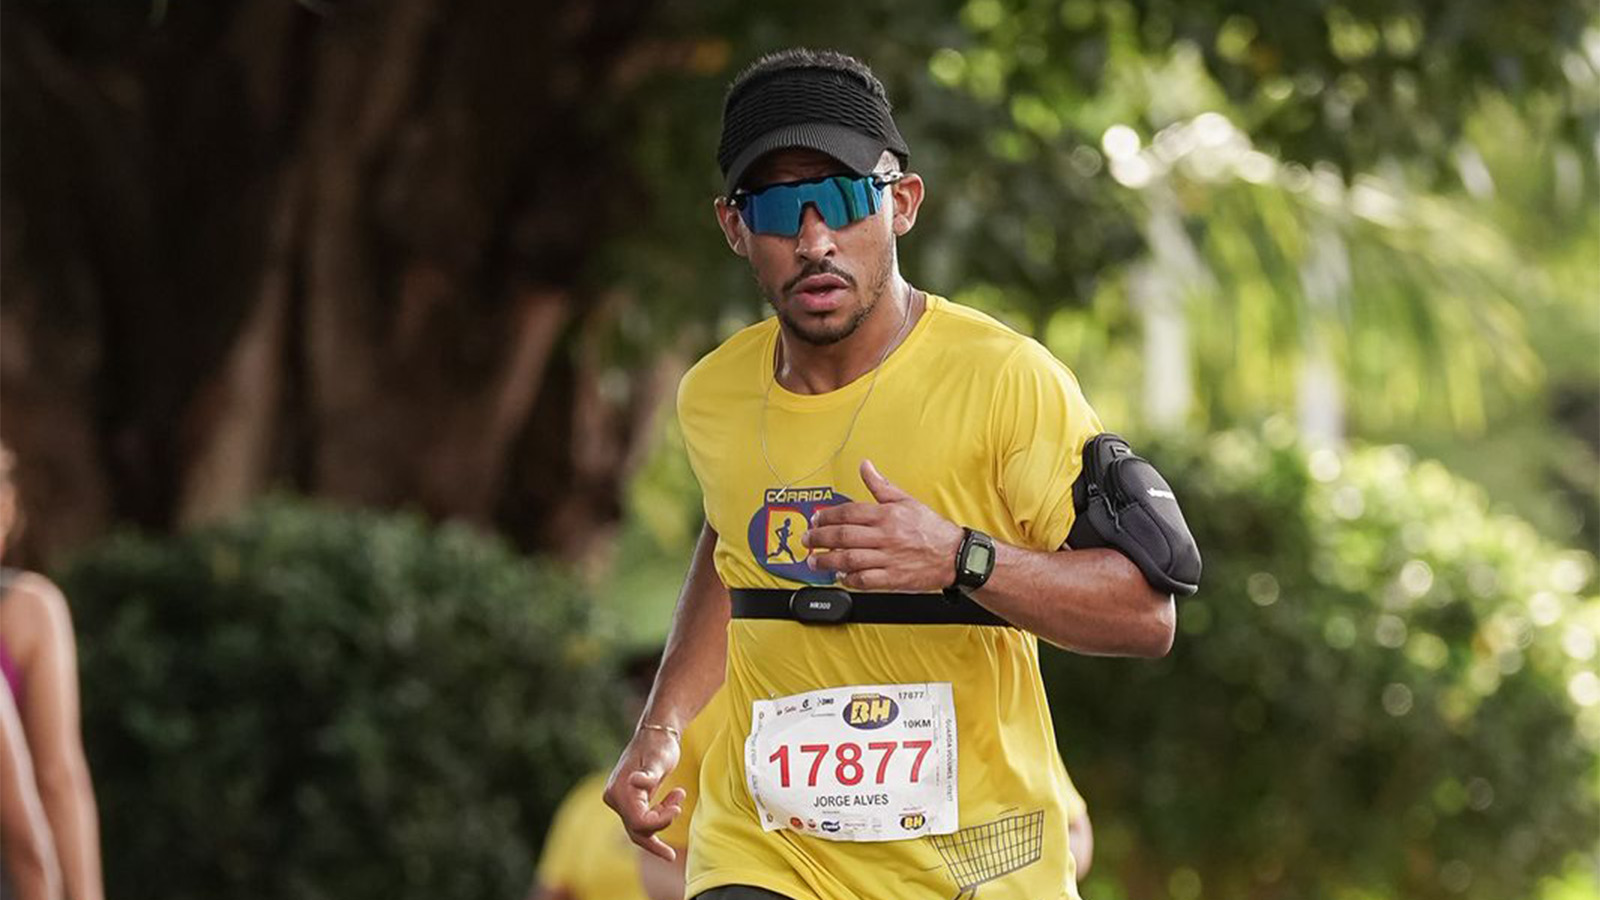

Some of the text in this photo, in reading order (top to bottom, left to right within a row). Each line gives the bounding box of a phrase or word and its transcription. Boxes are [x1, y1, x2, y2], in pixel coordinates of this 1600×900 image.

[766, 489, 833, 503] CORRIDA
[850, 699, 891, 724] BH
[903, 719, 931, 729] 10KM
[769, 740, 933, 788] 17877
[813, 794, 890, 807] JORGE ALVES
[904, 815, 923, 829] BH
